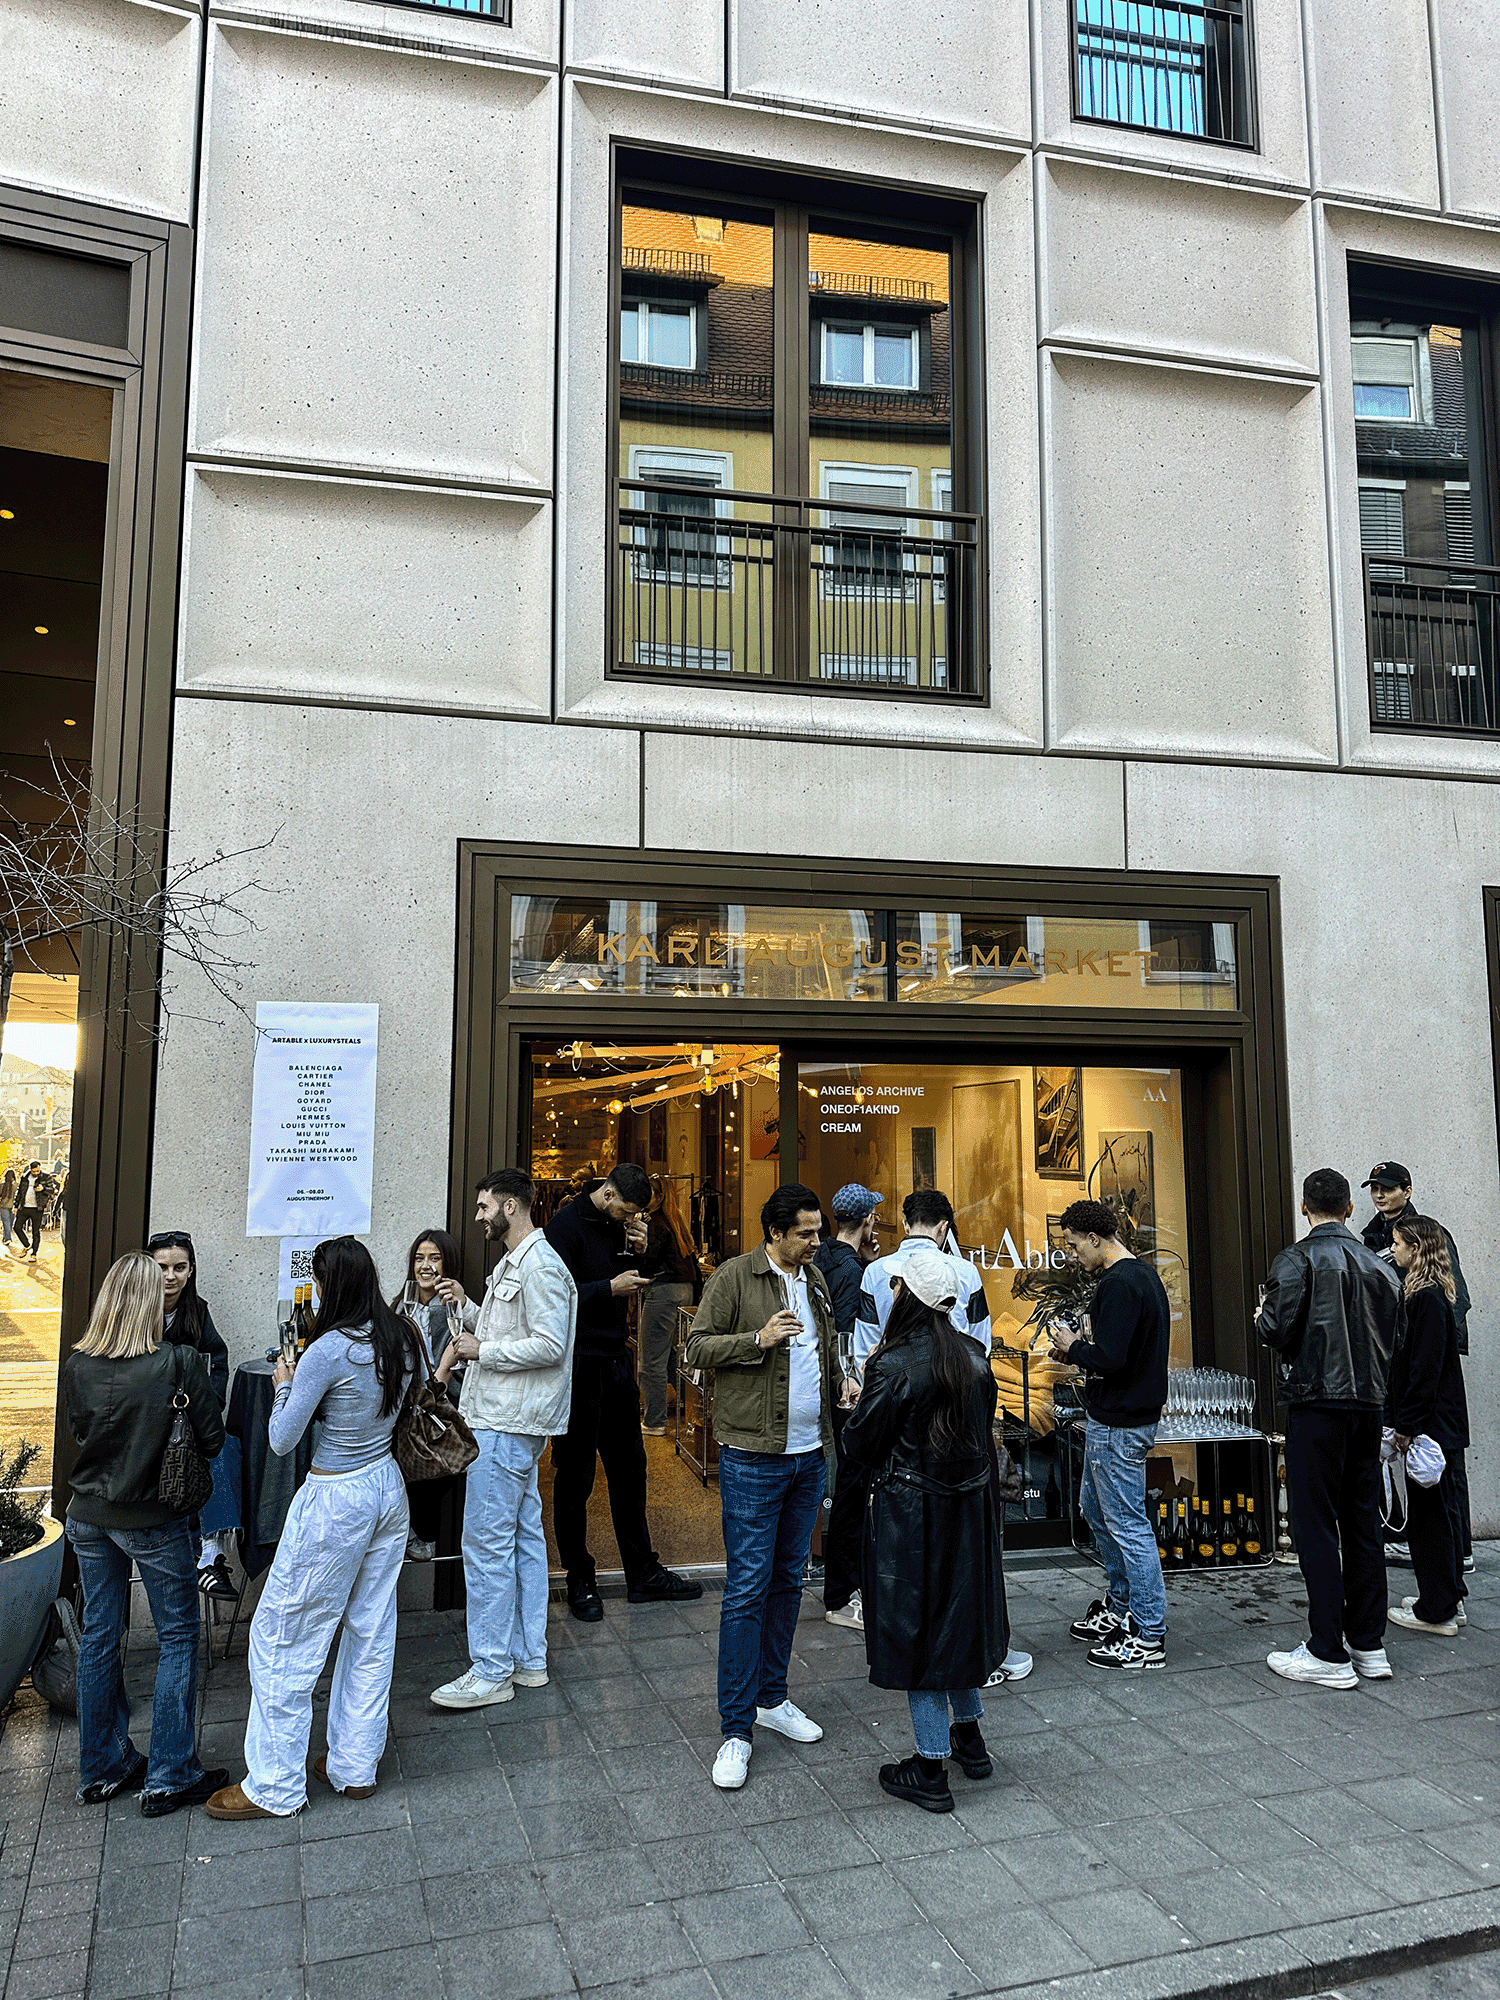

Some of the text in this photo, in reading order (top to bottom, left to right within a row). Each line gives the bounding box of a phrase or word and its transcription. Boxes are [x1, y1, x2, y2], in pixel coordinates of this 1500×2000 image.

[598, 933, 1159, 977] KARL AUGUST MARKET
[820, 1085, 925, 1096] ANGELOS ARCHIVE
[820, 1104, 900, 1115] ONEOF1AKIND
[820, 1122, 862, 1133] CREAM
[940, 1227, 1066, 1270] ArtAble
